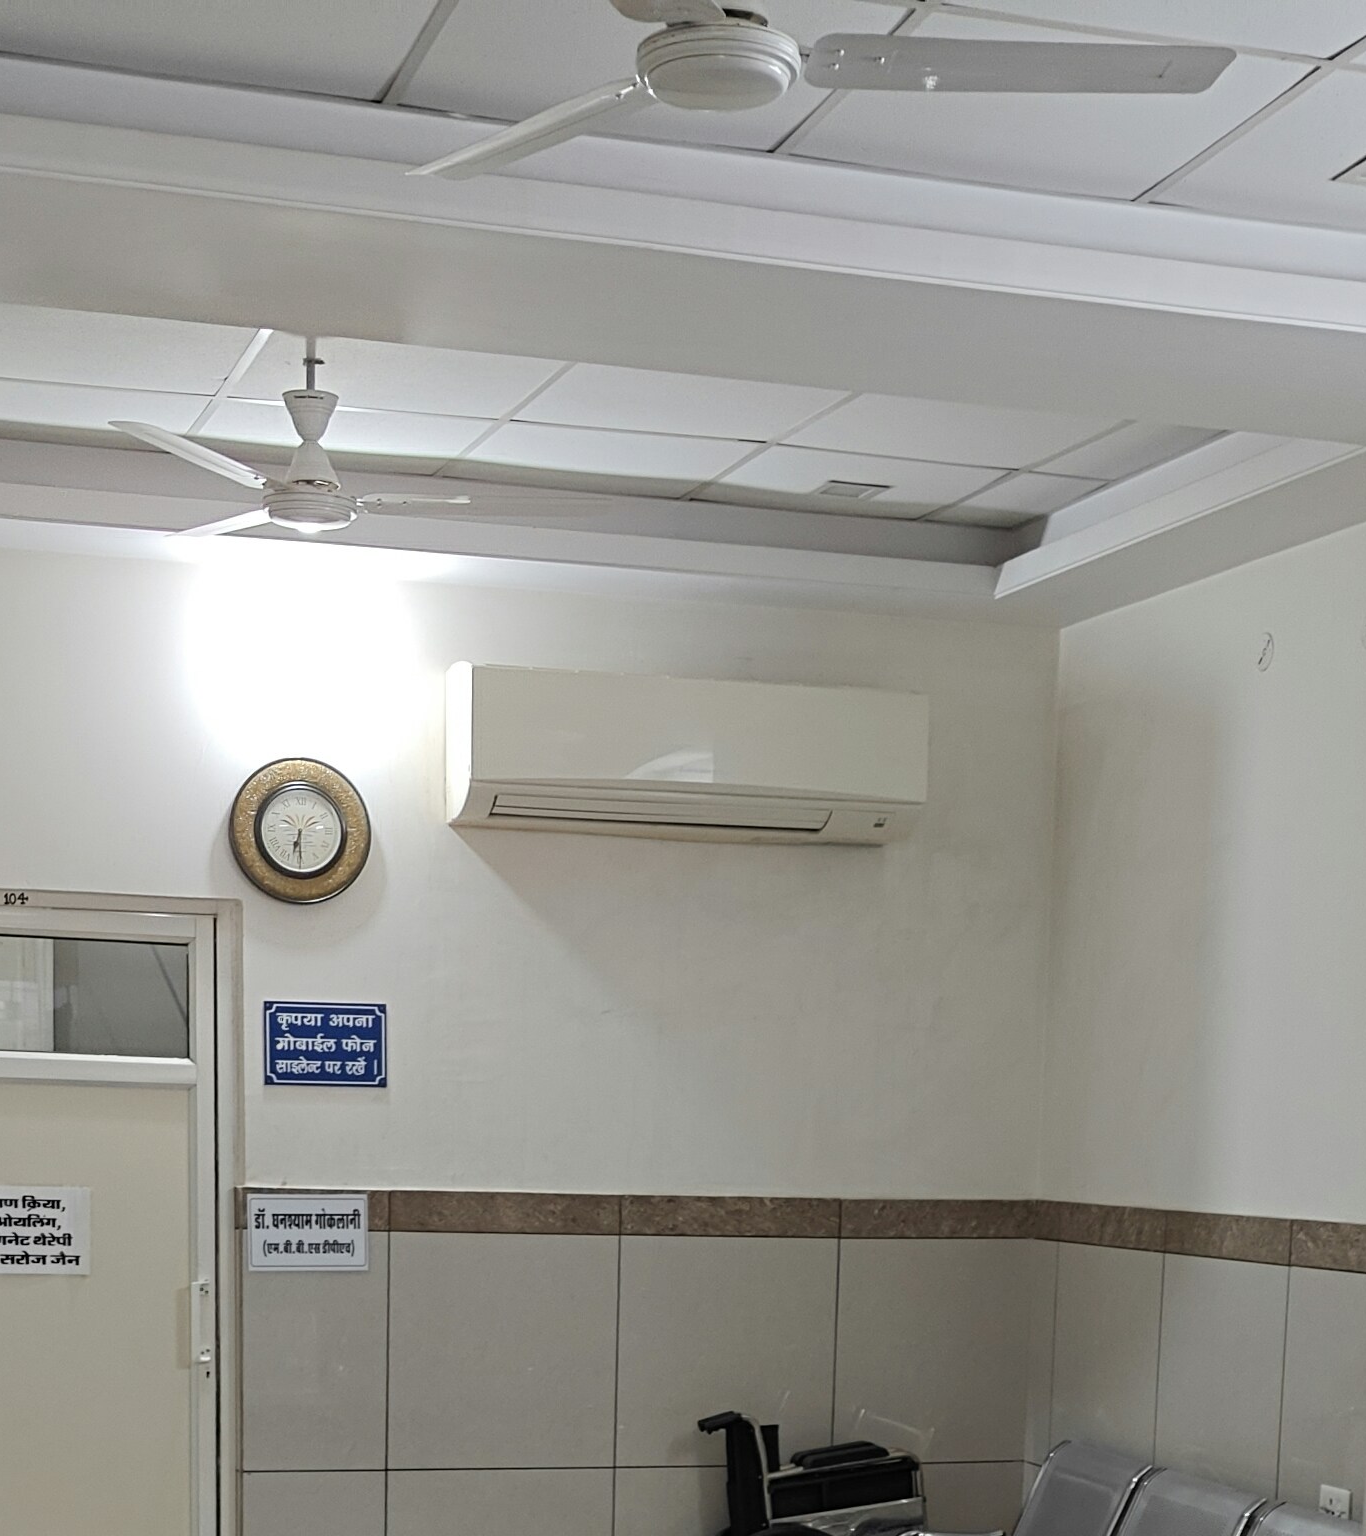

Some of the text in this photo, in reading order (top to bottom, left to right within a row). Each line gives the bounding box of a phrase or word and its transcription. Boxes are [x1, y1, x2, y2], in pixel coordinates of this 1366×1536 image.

[4, 892, 29, 905] 104
[275, 1012, 376, 1030] कृपया अपना
[275, 1033, 377, 1053] मोबाईल फोन
[275, 1056, 322, 1074] साइलेन्ट
[324, 1060, 343, 1074] पर
[22, 1195, 66, 1212] क्रिया,
[254, 1208, 270, 1230] डॉ.
[271, 1213, 313, 1230] घनश्याम
[0, 1250, 48, 1265] सरोज
[50, 1251, 81, 1266] जैन
